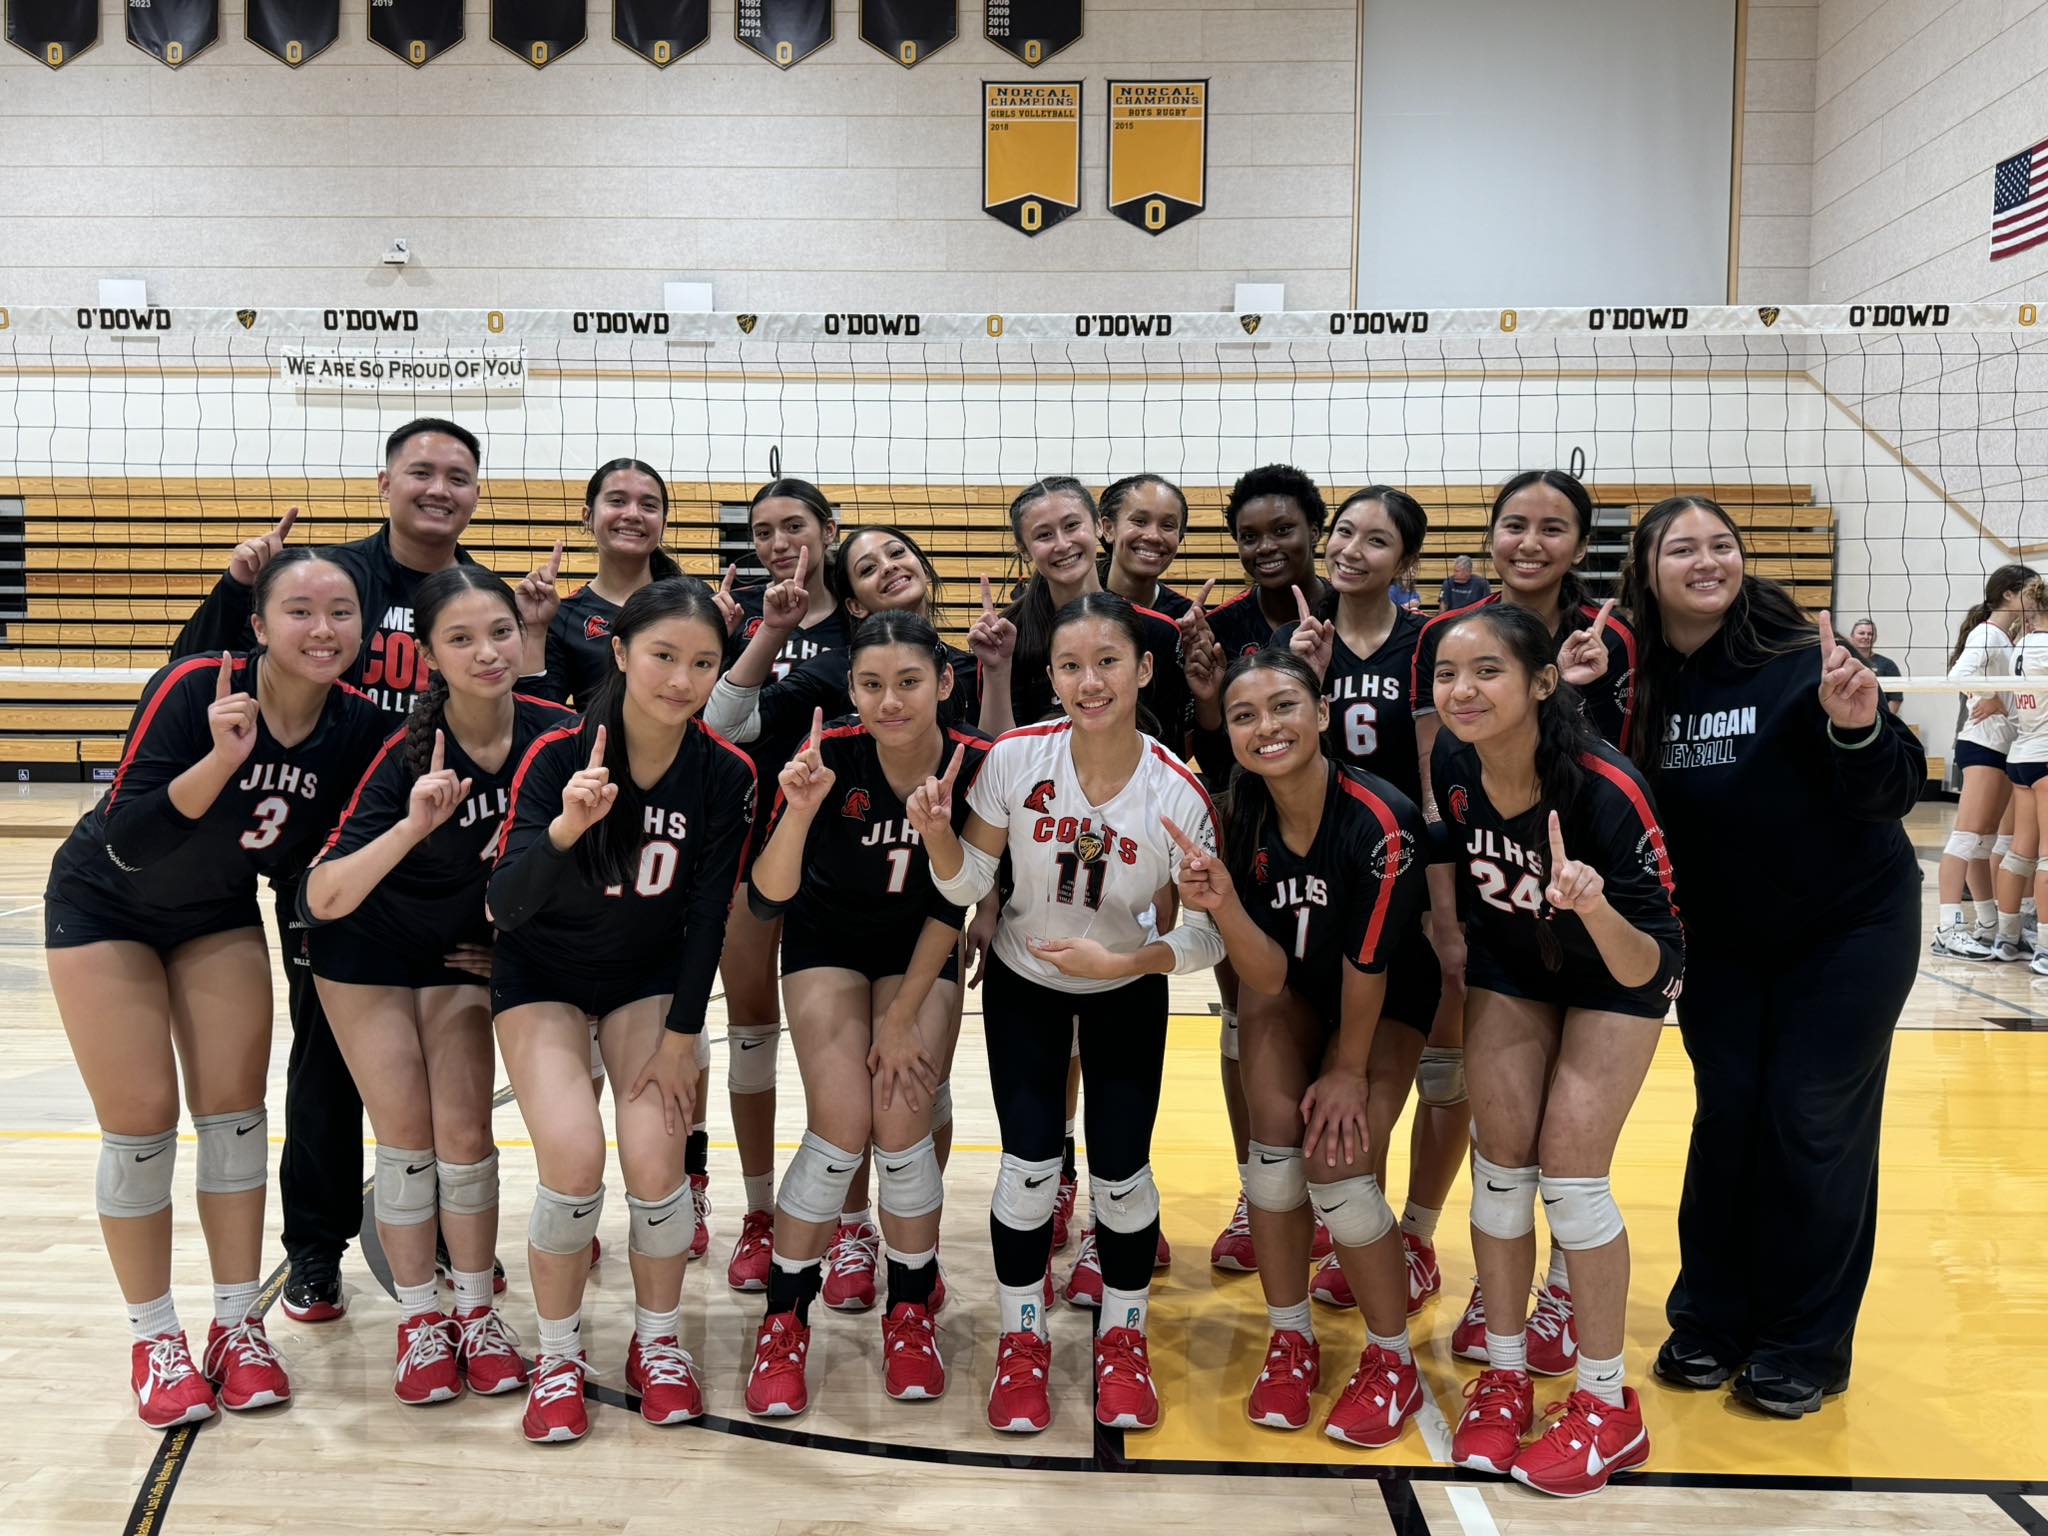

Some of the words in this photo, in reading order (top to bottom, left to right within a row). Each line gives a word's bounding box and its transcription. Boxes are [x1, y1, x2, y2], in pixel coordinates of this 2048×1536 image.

[740, 9, 761, 17] 1993
[740, 19, 761, 27] 1994
[988, 7, 1010, 16] 2009
[988, 17, 1010, 26] 2010
[739, 29, 761, 37] 2012
[988, 27, 1010, 36] 2013
[991, 97, 1073, 106] CHAMPIONS
[997, 88, 1071, 98] NORCAL
[1116, 96, 1199, 105] CHAMPIONS
[1120, 87, 1194, 96] NORCAL
[991, 109, 1016, 118] GIRLS
[1018, 110, 1075, 119] VOLLEYBALL
[1115, 122, 1134, 130] 2015
[1128, 108, 1152, 117] BOYS
[1156, 108, 1187, 117] RUGBY
[1021, 200, 1042, 230] O
[1145, 200, 1166, 229] O
[77, 309, 171, 330] O'DOWD
[323, 309, 419, 332] O'DOWD
[573, 312, 670, 334] O'DOWD
[824, 313, 920, 336] O'DOWD
[1075, 315, 1172, 337] O'DOWD
[1329, 311, 1429, 334] O'DOWD
[1588, 308, 1688, 331] O'DOWD
[1849, 305, 1950, 328] O'DOWD
[1327, 673, 1400, 703] JLHS
[1344, 702, 1377, 756] 6
[239, 763, 318, 800] JLHS
[460, 788, 508, 827] JLH
[239, 796, 290, 850] 3
[644, 805, 687, 840] HS
[861, 818, 920, 846] JLH
[1371, 832, 1395, 858] MISSION
[1395, 829, 1415, 844] VALLEY
[1466, 828, 1544, 877] JLHS
[886, 847, 912, 893] 1
[1055, 851, 1108, 912] 11
[1470, 859, 1556, 919] 24
